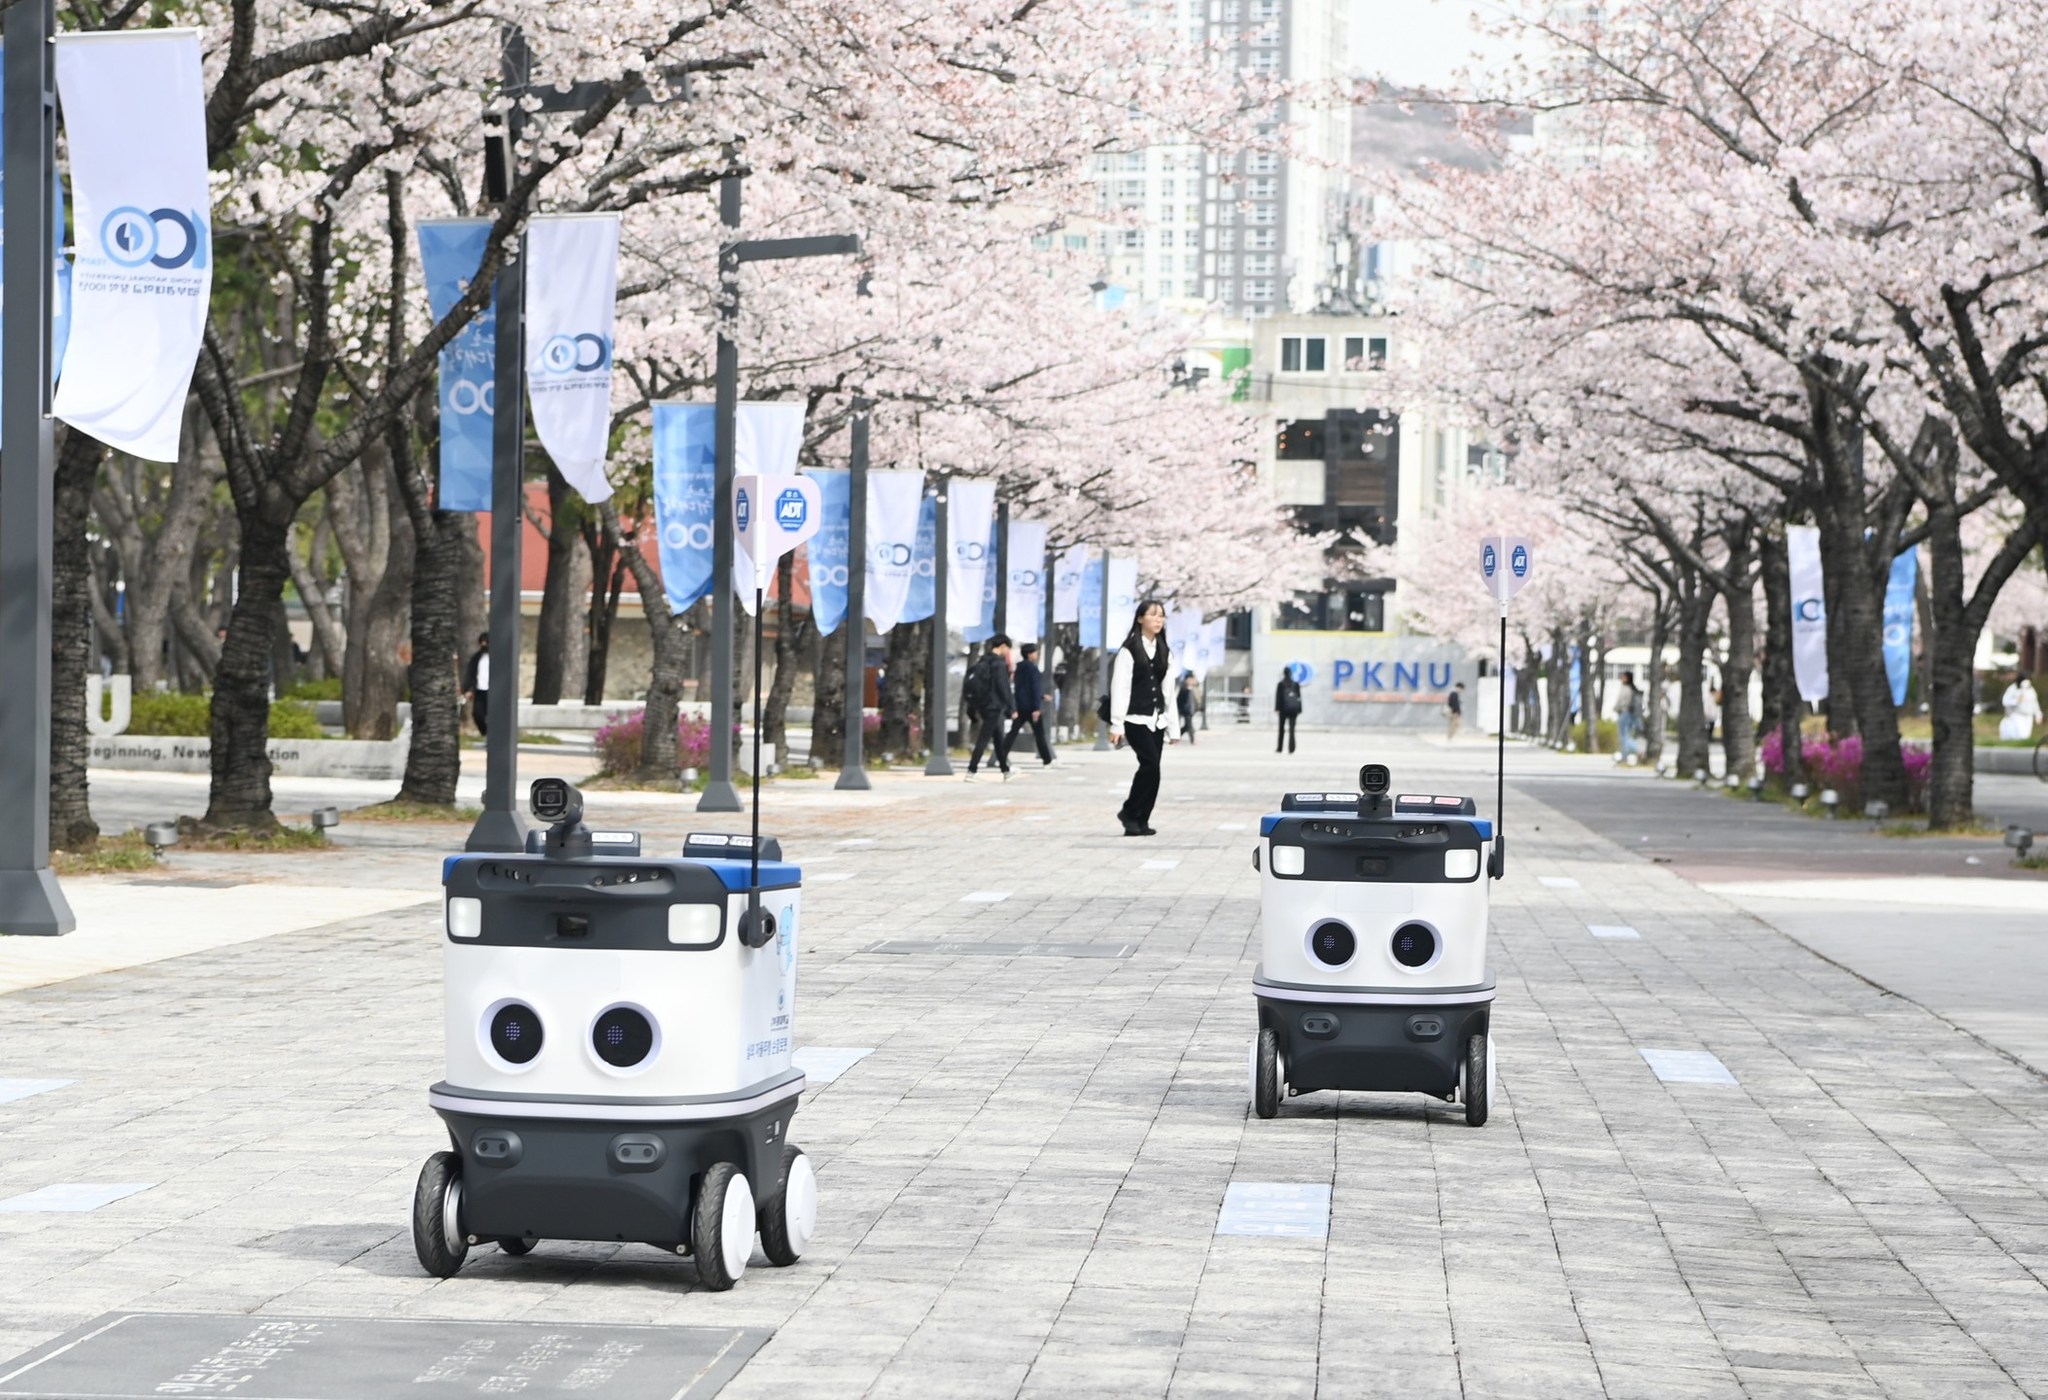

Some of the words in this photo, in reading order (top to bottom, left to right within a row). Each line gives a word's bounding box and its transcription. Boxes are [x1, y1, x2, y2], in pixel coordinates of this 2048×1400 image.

[738, 502, 748, 518] ADT
[780, 501, 804, 519] ADT
[1514, 555, 1526, 568] ADT
[1333, 659, 1451, 689] PKNU
